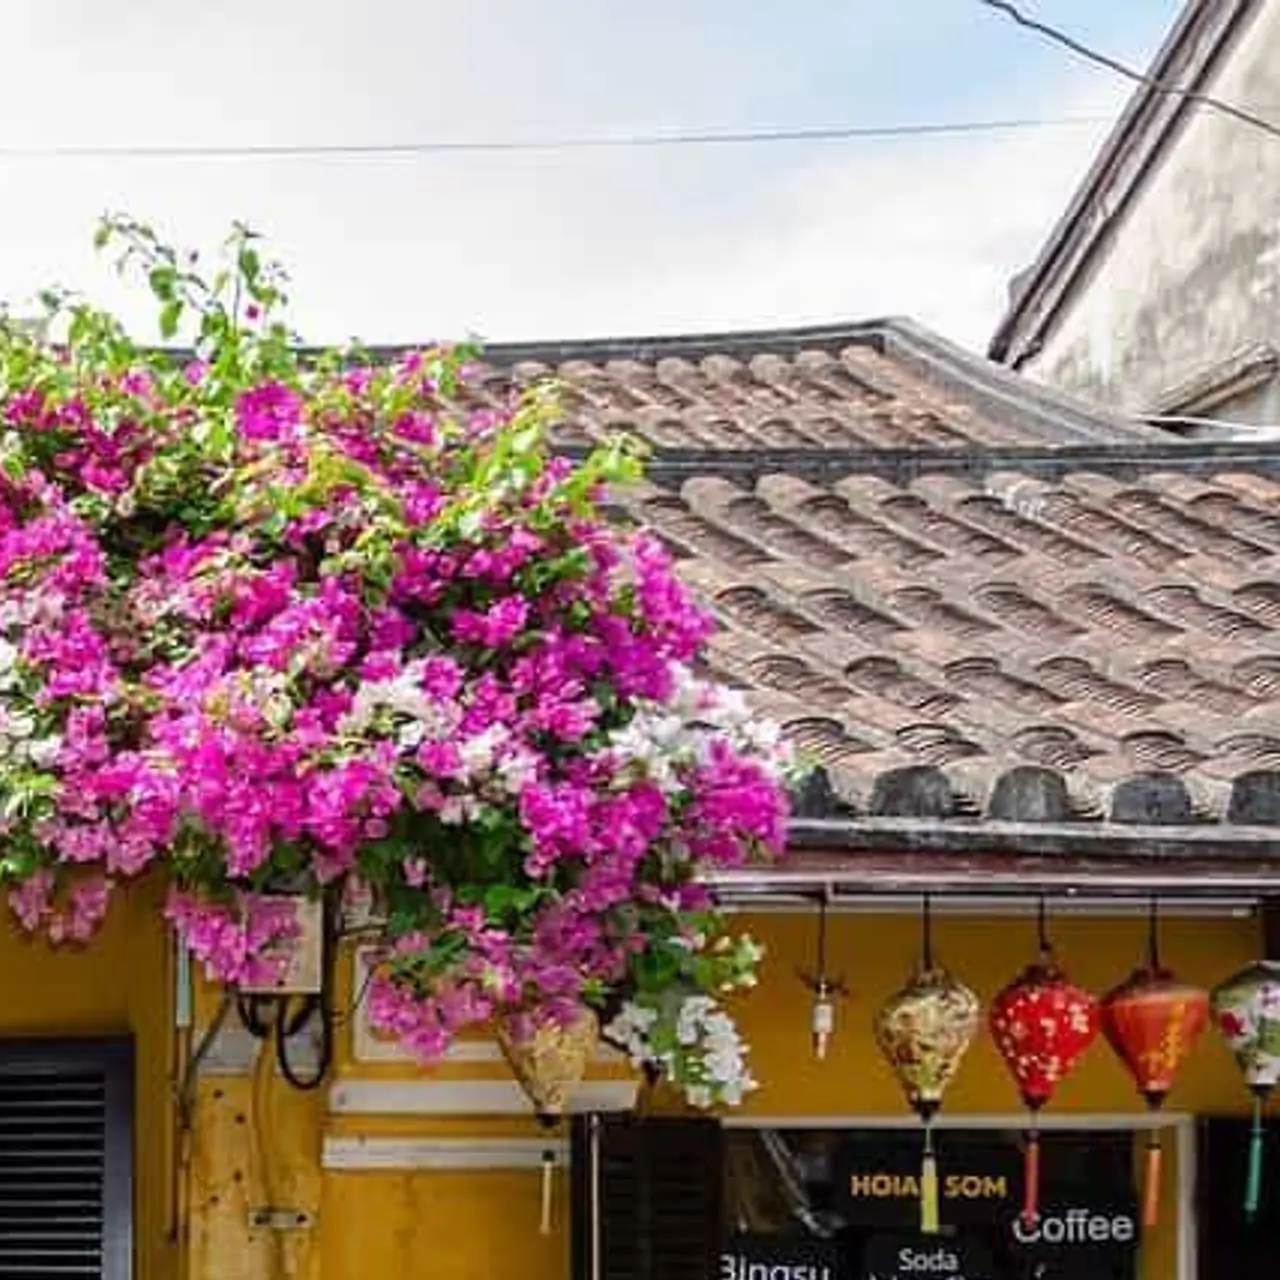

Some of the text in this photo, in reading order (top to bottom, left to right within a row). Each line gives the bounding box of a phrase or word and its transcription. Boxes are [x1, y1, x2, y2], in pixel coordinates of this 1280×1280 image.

[851, 1175, 1007, 1197] HOIA SOM
[1013, 1209, 1134, 1243] Coffee
[898, 1249, 958, 1271] Soda
